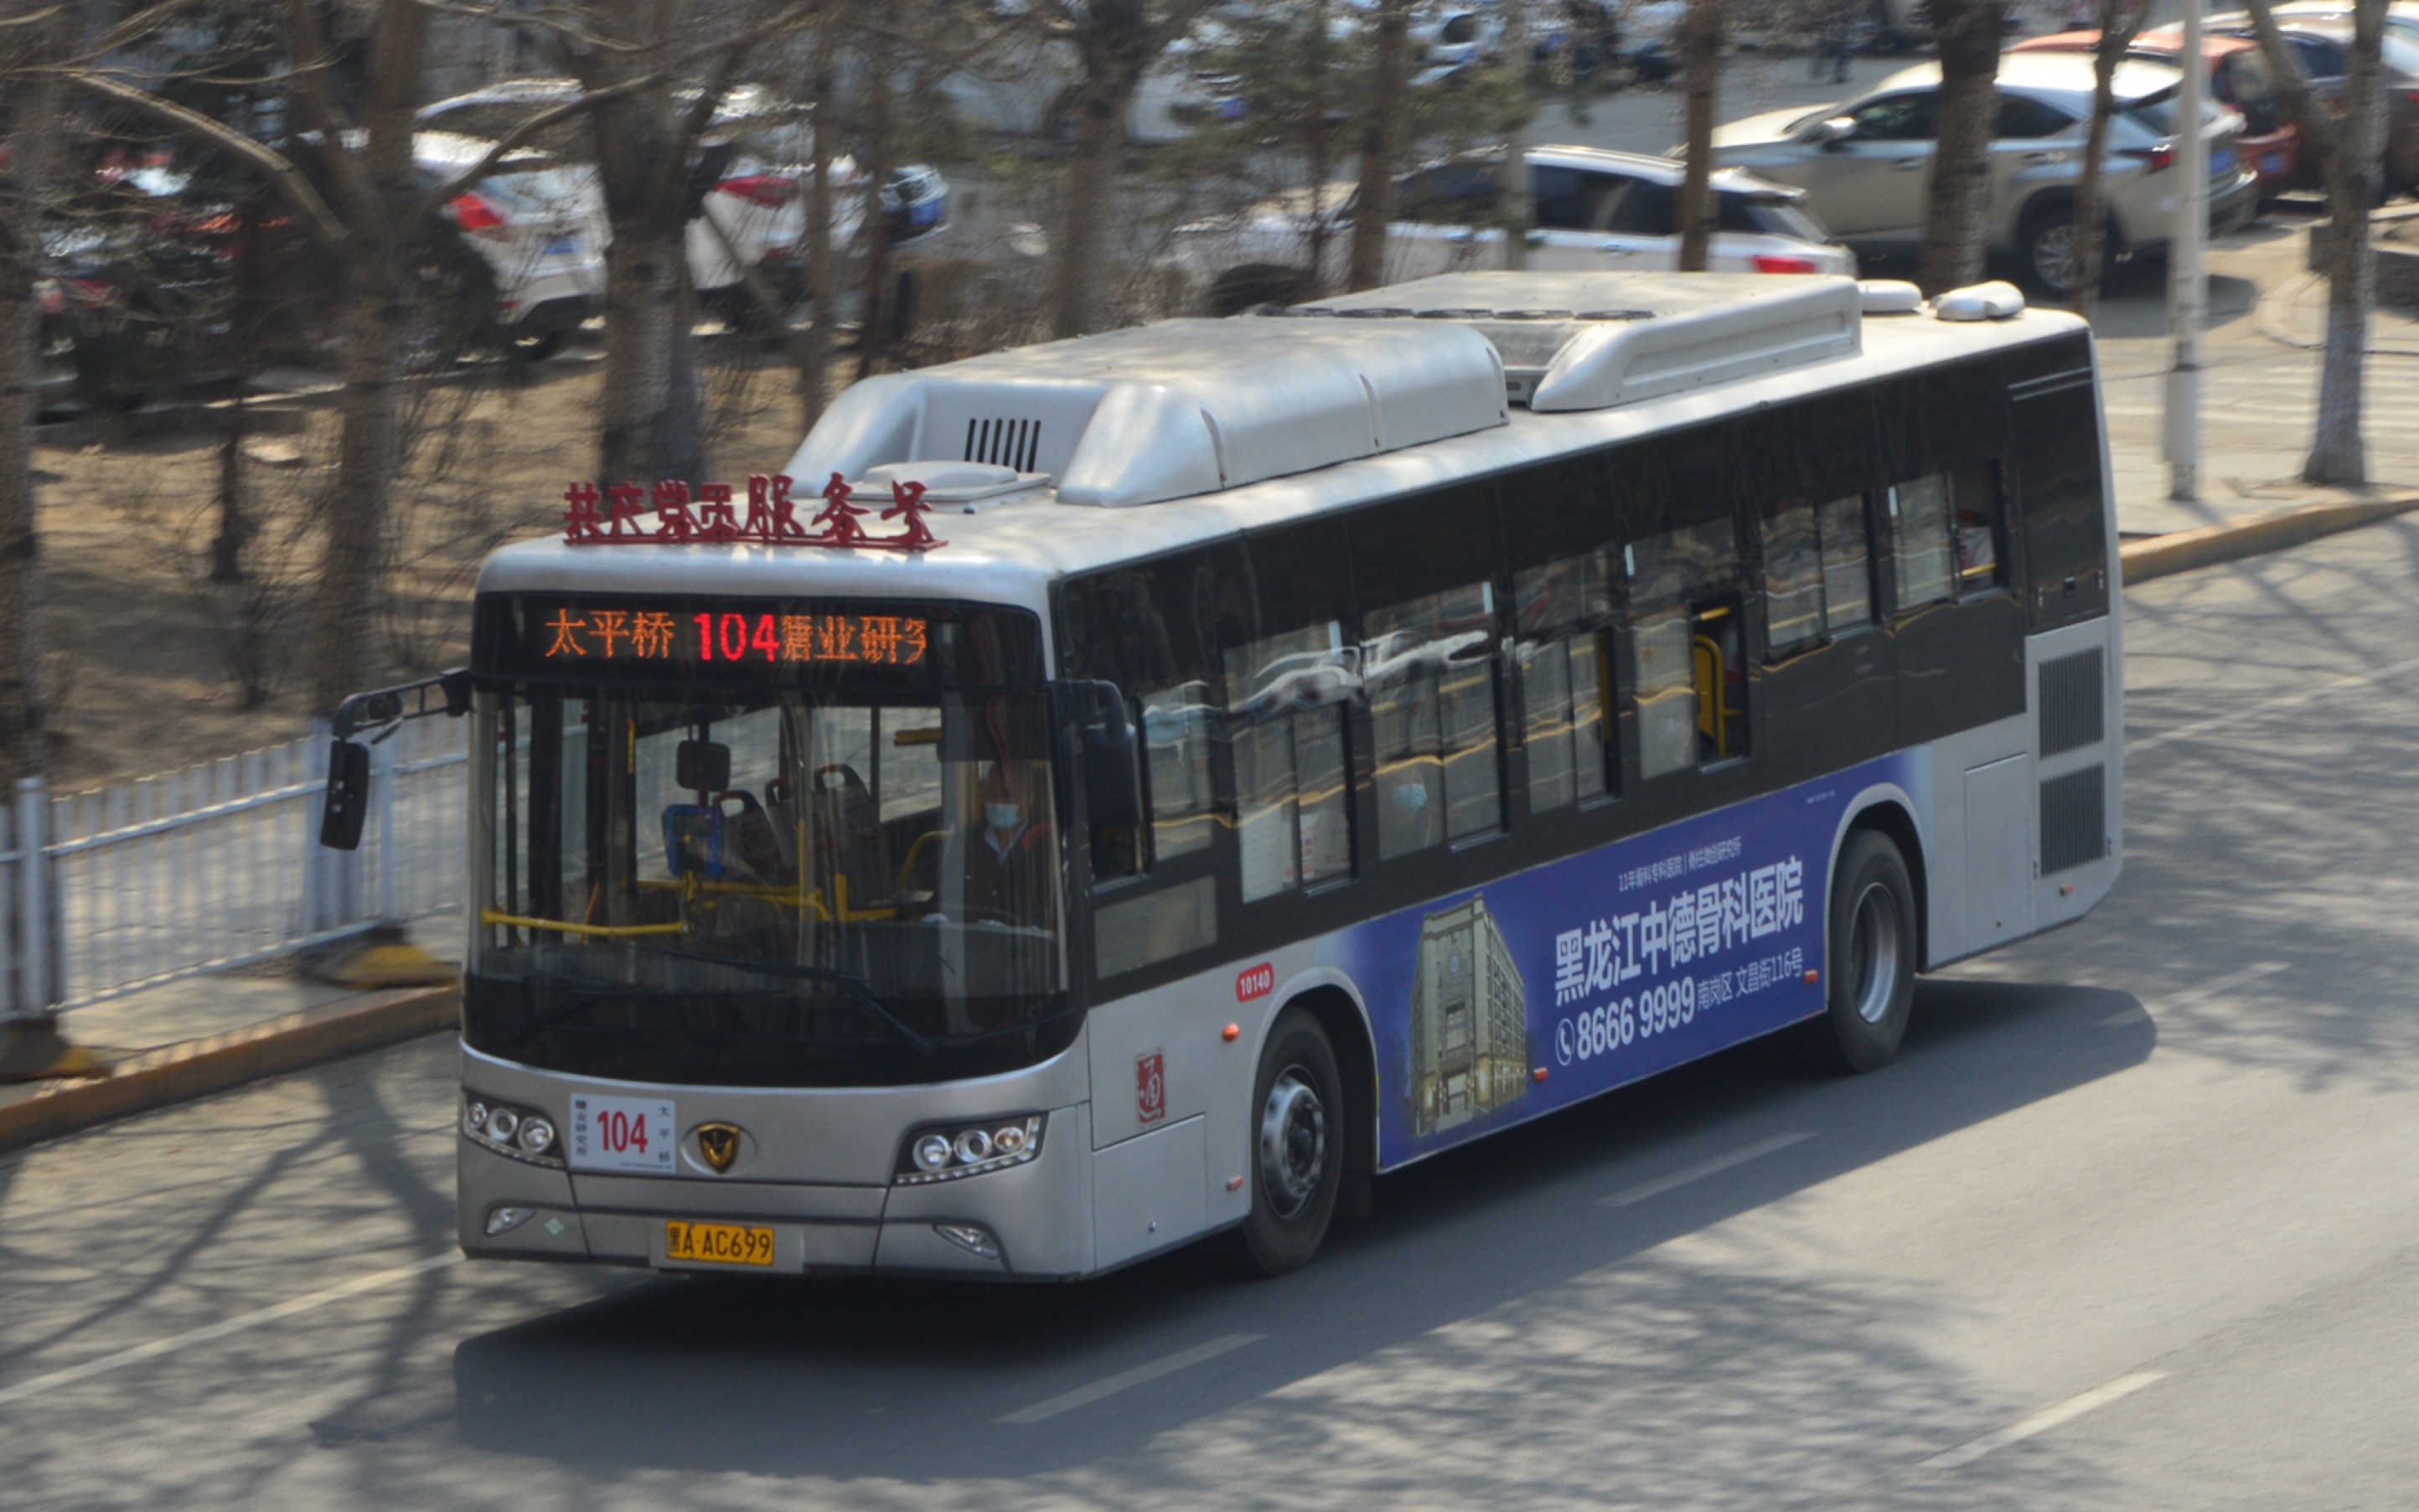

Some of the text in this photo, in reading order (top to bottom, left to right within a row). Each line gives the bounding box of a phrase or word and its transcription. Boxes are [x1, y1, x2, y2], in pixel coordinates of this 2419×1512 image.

[563, 472, 934, 550] 共产党员服务号
[545, 608, 675, 659] 太平桥
[693, 612, 780, 662] 104
[1555, 855, 1803, 1007] 黑龙江中德骨科医院
[1240, 969, 1270, 997] 10140
[1735, 947, 1803, 999] 文昌街116号
[1577, 976, 1695, 1059] 8666 9999
[597, 1110, 649, 1153] 104
